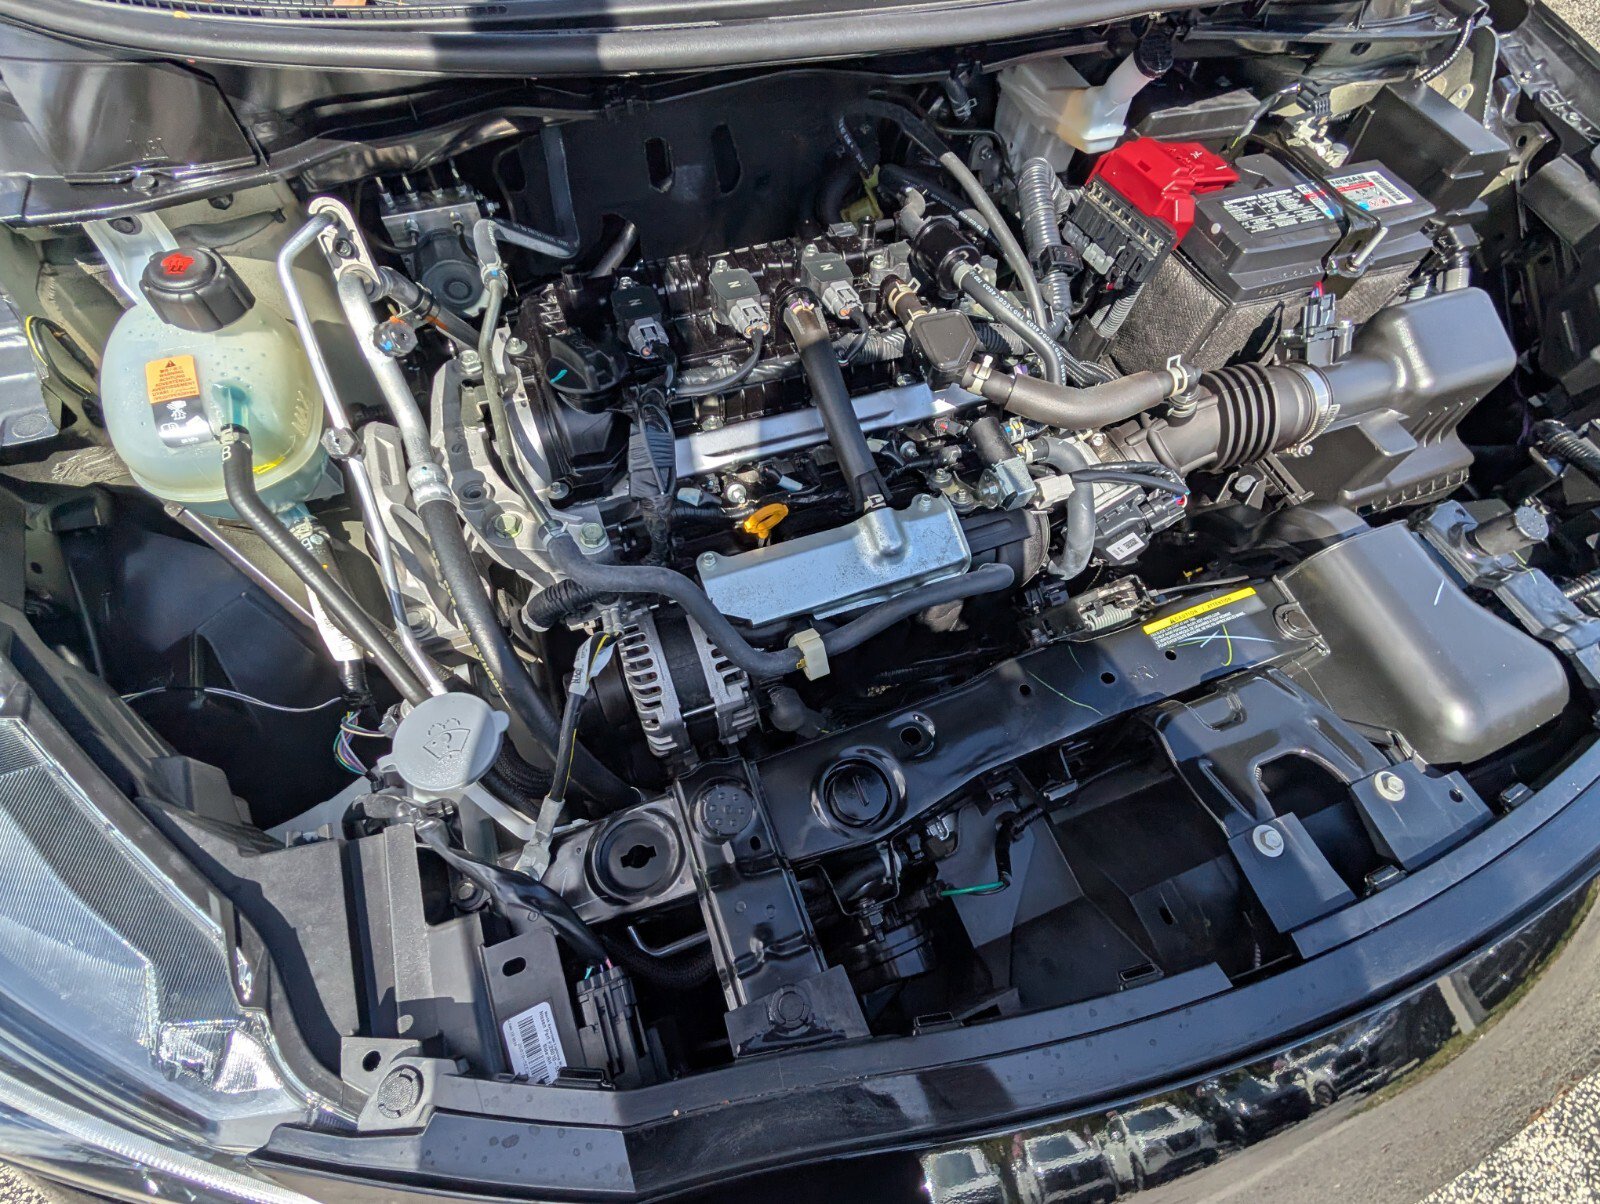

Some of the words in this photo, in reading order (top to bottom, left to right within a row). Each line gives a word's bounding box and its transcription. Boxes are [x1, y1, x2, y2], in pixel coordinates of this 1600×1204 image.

[1331, 175, 1366, 186] NISSAN
[221, 445, 232, 461] B
[1174, 609, 1199, 621] CAUTION
[1207, 597, 1232, 609] ATTENTION
